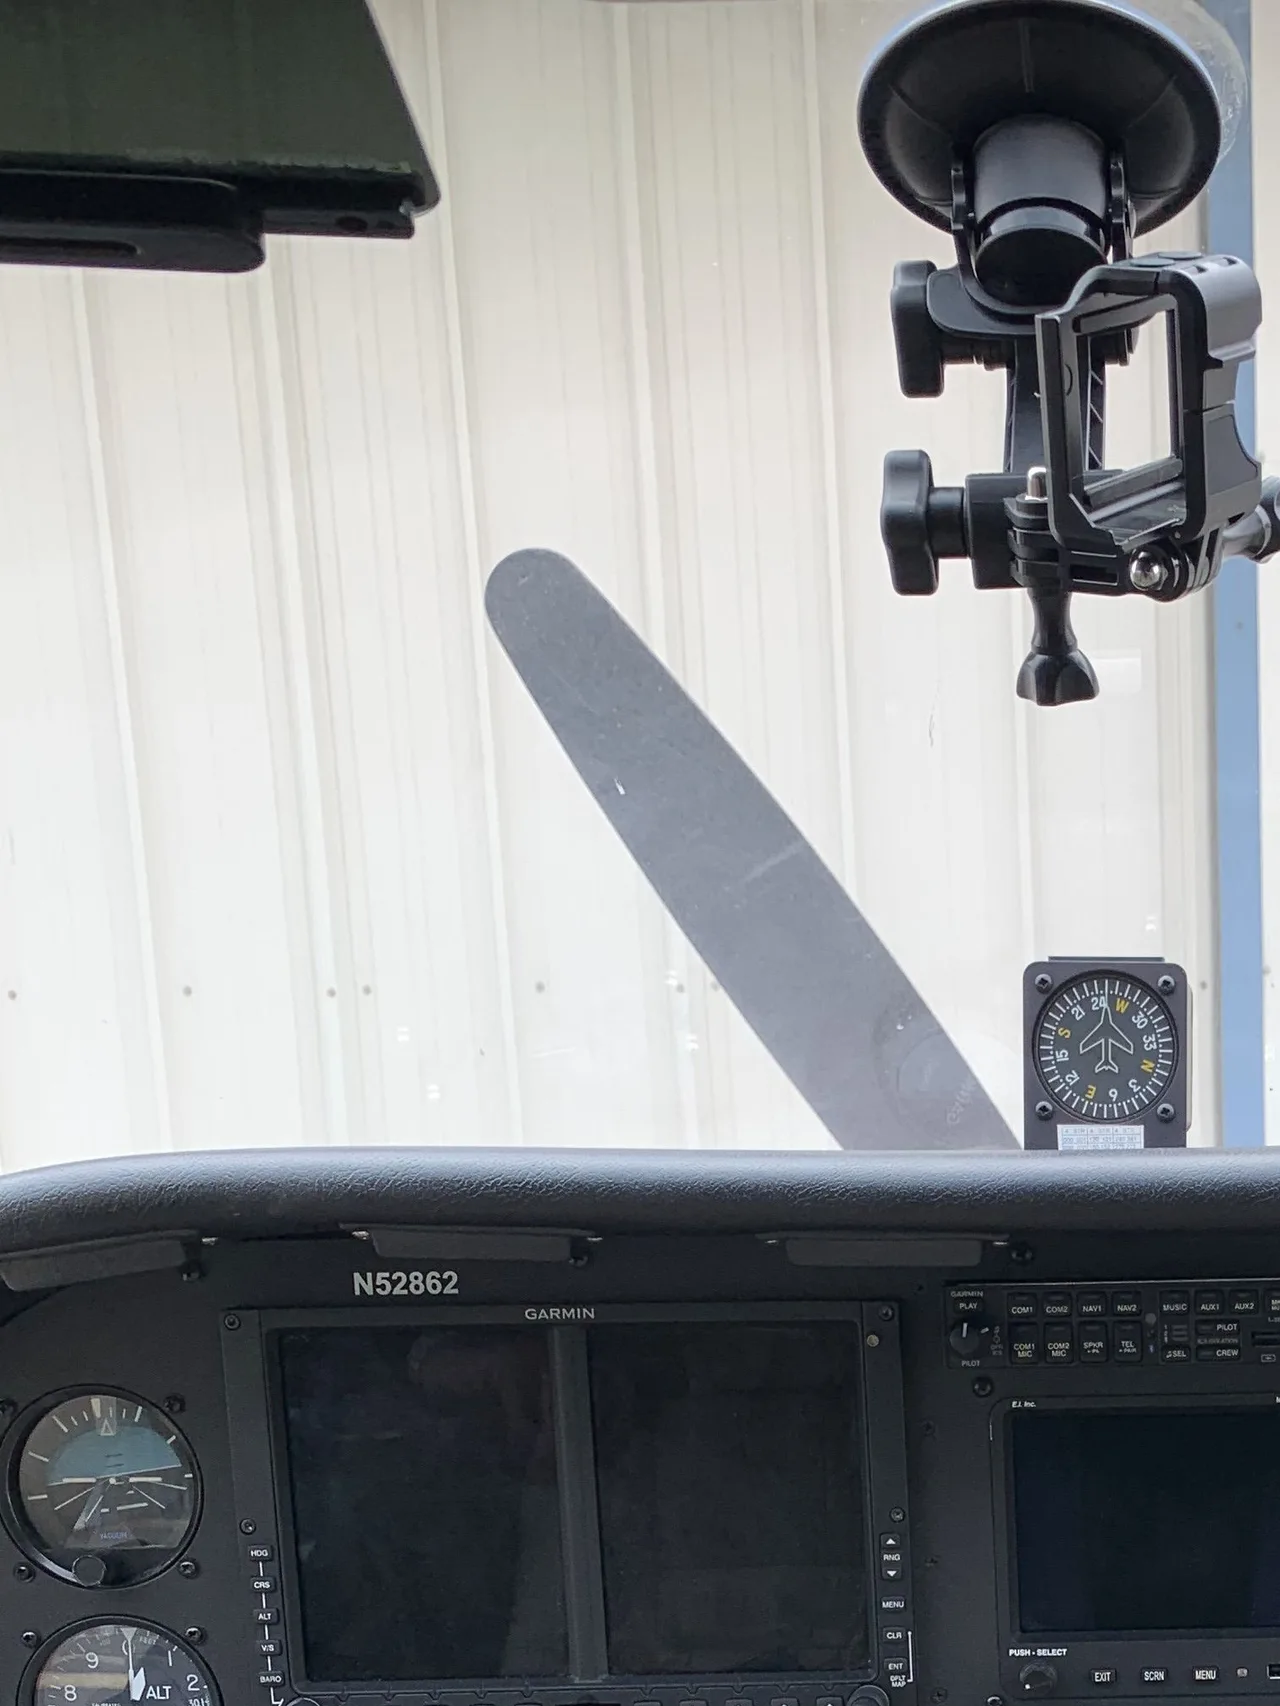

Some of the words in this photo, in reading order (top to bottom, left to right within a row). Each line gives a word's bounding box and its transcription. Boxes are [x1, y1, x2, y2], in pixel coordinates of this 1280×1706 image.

[1092, 996, 1107, 1010] 24
[1132, 1012, 1148, 1029] 30
[353, 1271, 459, 1296] N52862
[525, 1308, 595, 1320] GARMIN
[250, 1549, 268, 1557] HDG
[1095, 1671, 1111, 1682] EXIT
[1195, 1669, 1216, 1680] MENU
[146, 1686, 171, 1699] ALT
